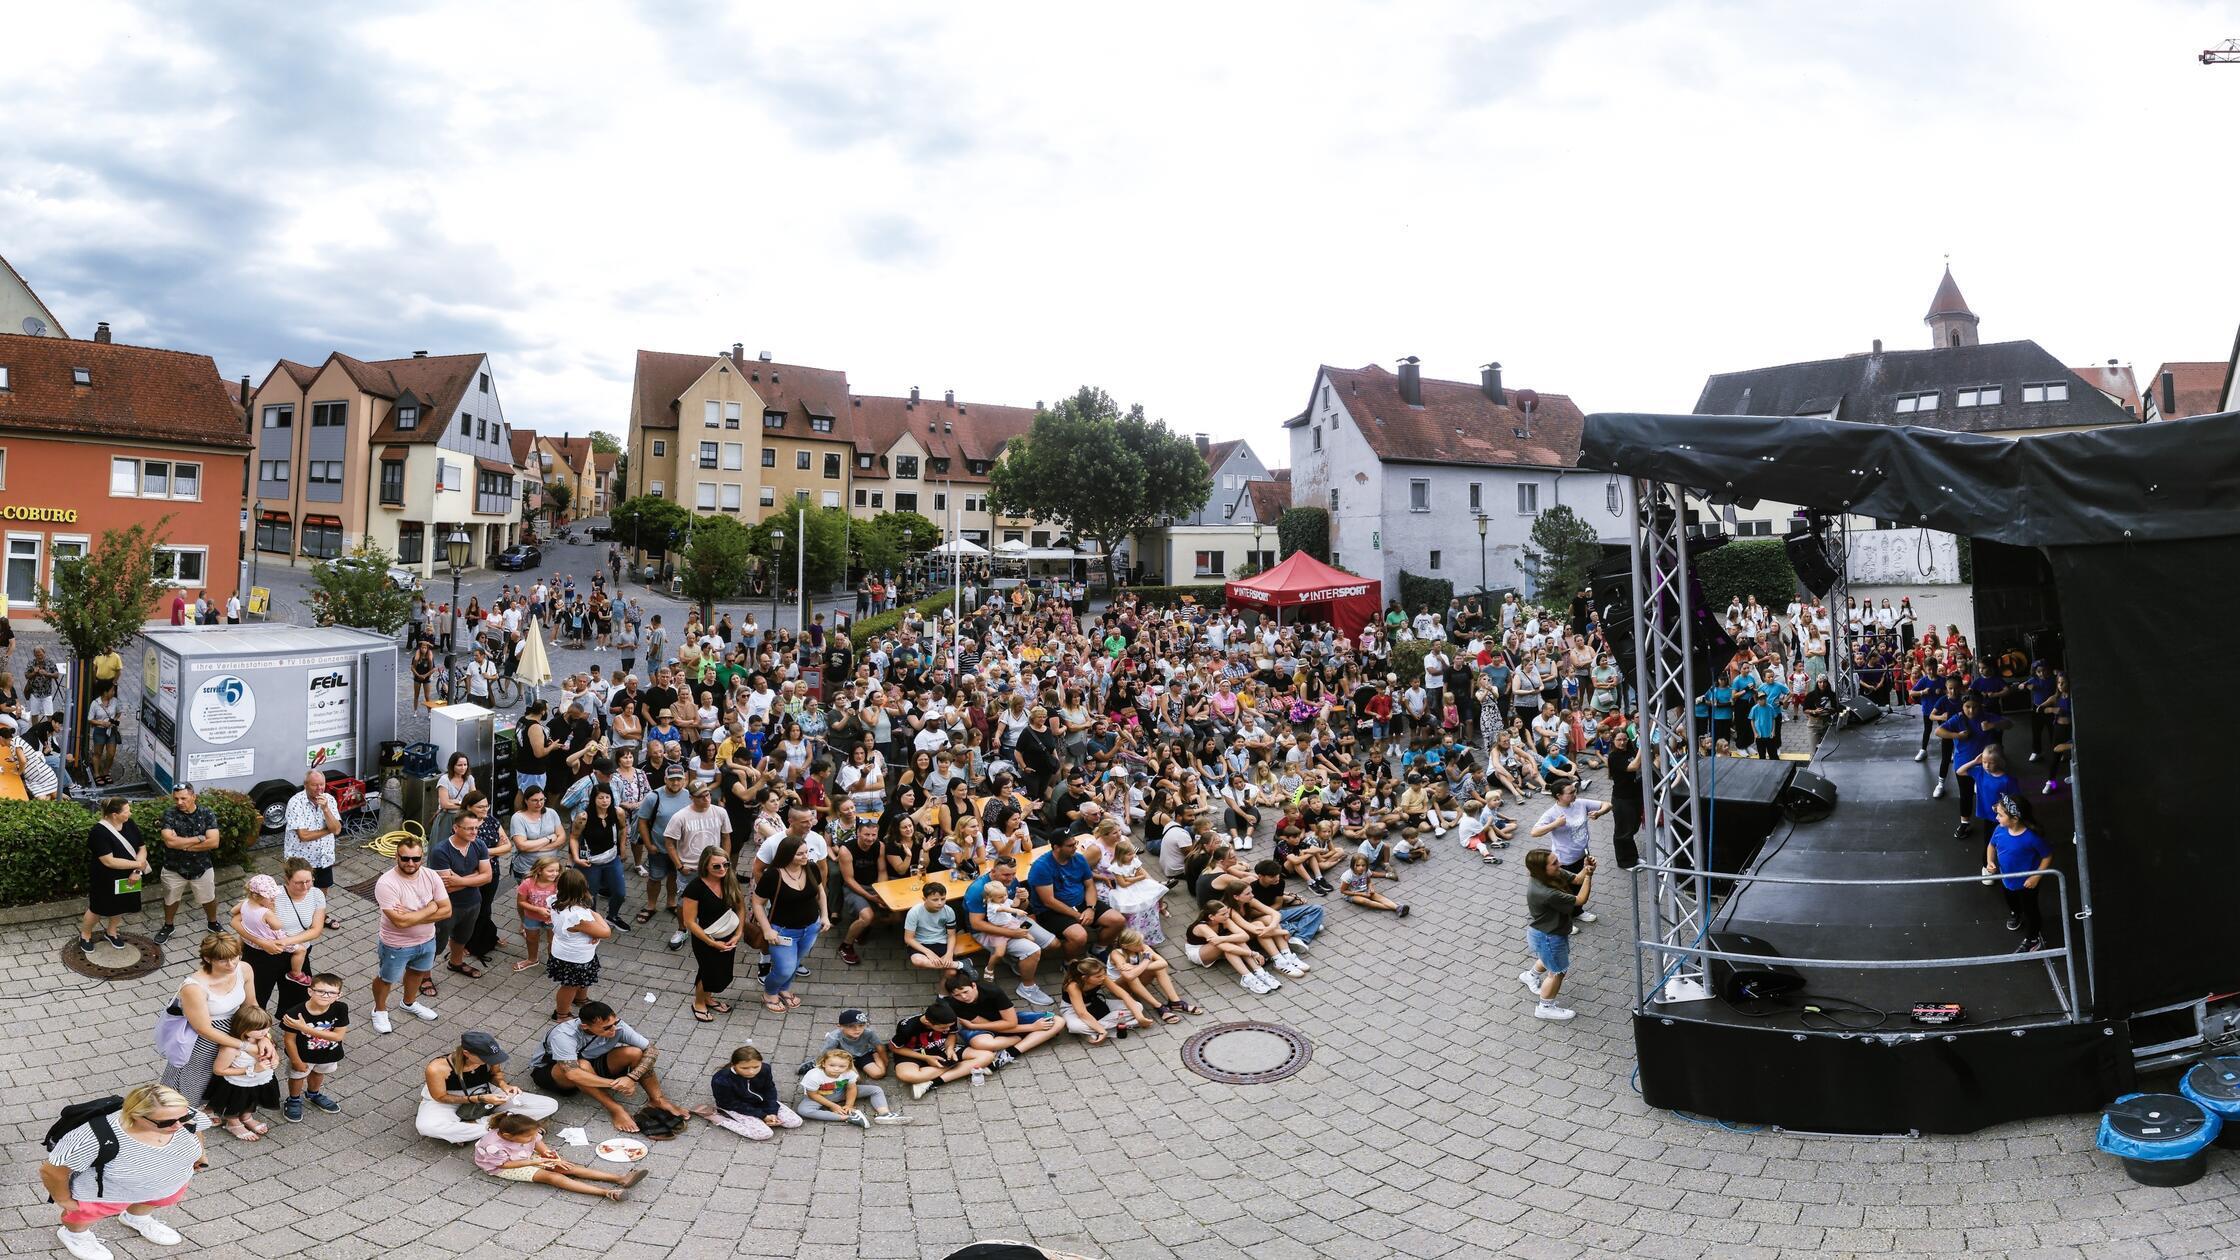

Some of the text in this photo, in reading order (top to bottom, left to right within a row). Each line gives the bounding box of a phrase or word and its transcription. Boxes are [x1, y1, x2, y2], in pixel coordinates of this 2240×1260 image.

[1238, 587, 1269, 602] INTERSPORT
[1310, 586, 1367, 601] INTERSPORT
[203, 679, 240, 704] service 5
